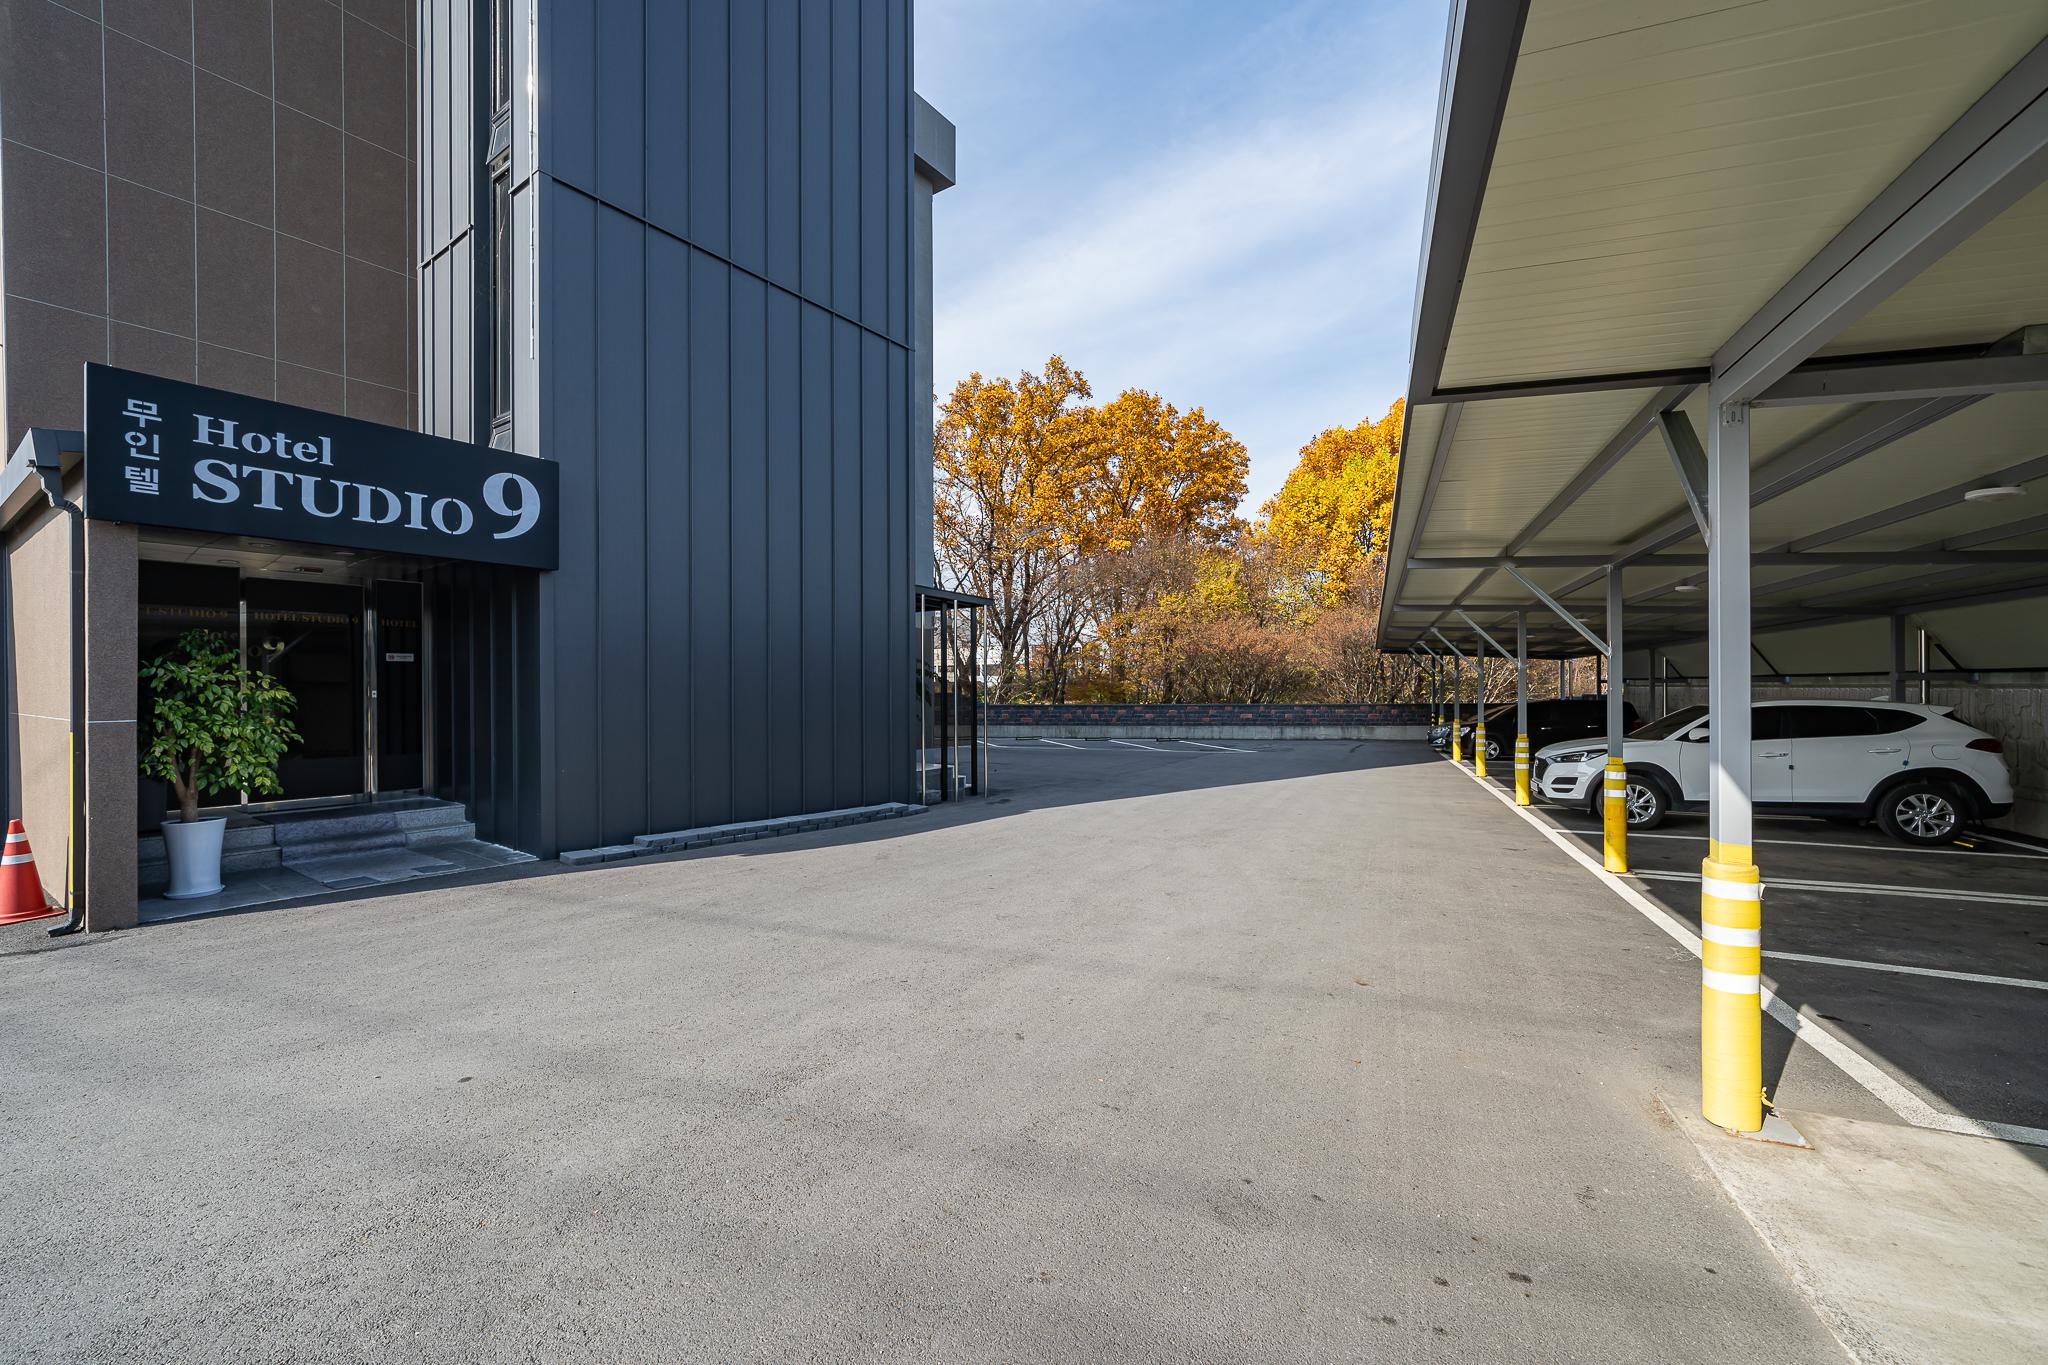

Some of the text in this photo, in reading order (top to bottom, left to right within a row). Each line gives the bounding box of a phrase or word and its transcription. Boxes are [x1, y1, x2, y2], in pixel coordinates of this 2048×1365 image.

[122, 398, 163, 496] 무인텔
[192, 413, 334, 467] Hotel
[192, 458, 541, 540] STUDIO 9
